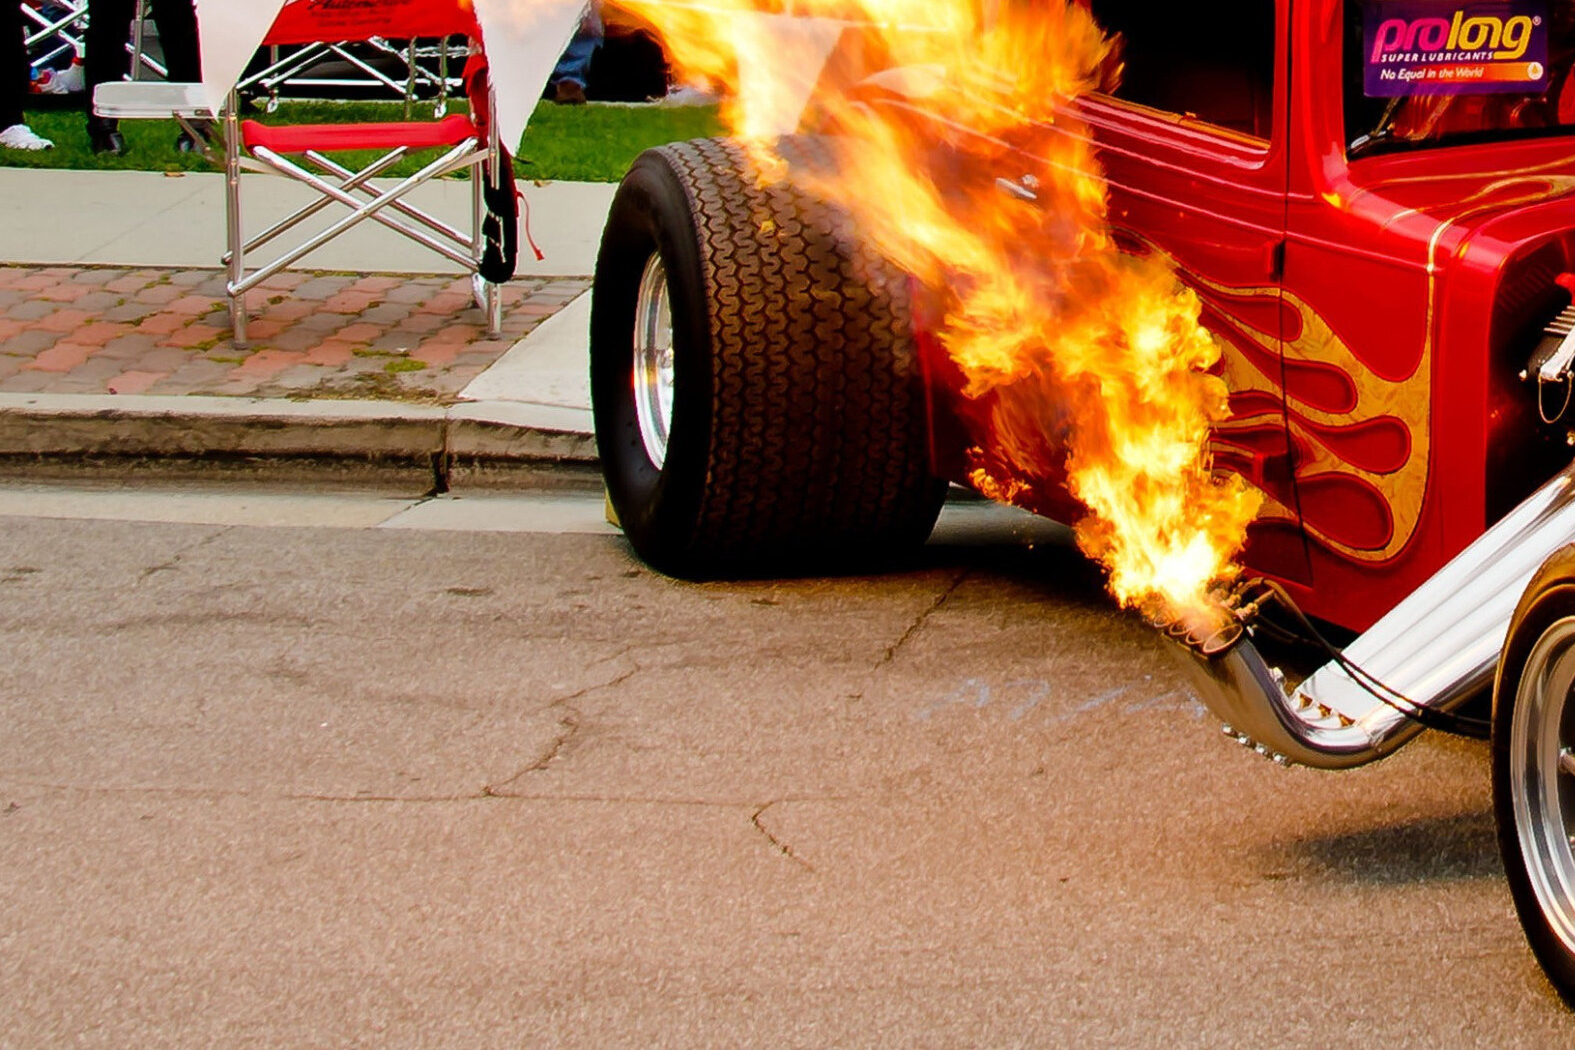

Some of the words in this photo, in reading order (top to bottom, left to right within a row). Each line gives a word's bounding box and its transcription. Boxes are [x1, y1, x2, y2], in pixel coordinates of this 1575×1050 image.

[1370, 10, 1533, 64] prolong
[1380, 53, 1419, 63] SUPER
[1421, 51, 1494, 62] LUBRICANTS
[1380, 69, 1396, 81] No
[1398, 68, 1426, 82] Equal
[1426, 68, 1438, 79] in
[1438, 67, 1454, 78] the
[1455, 66, 1485, 78] World
